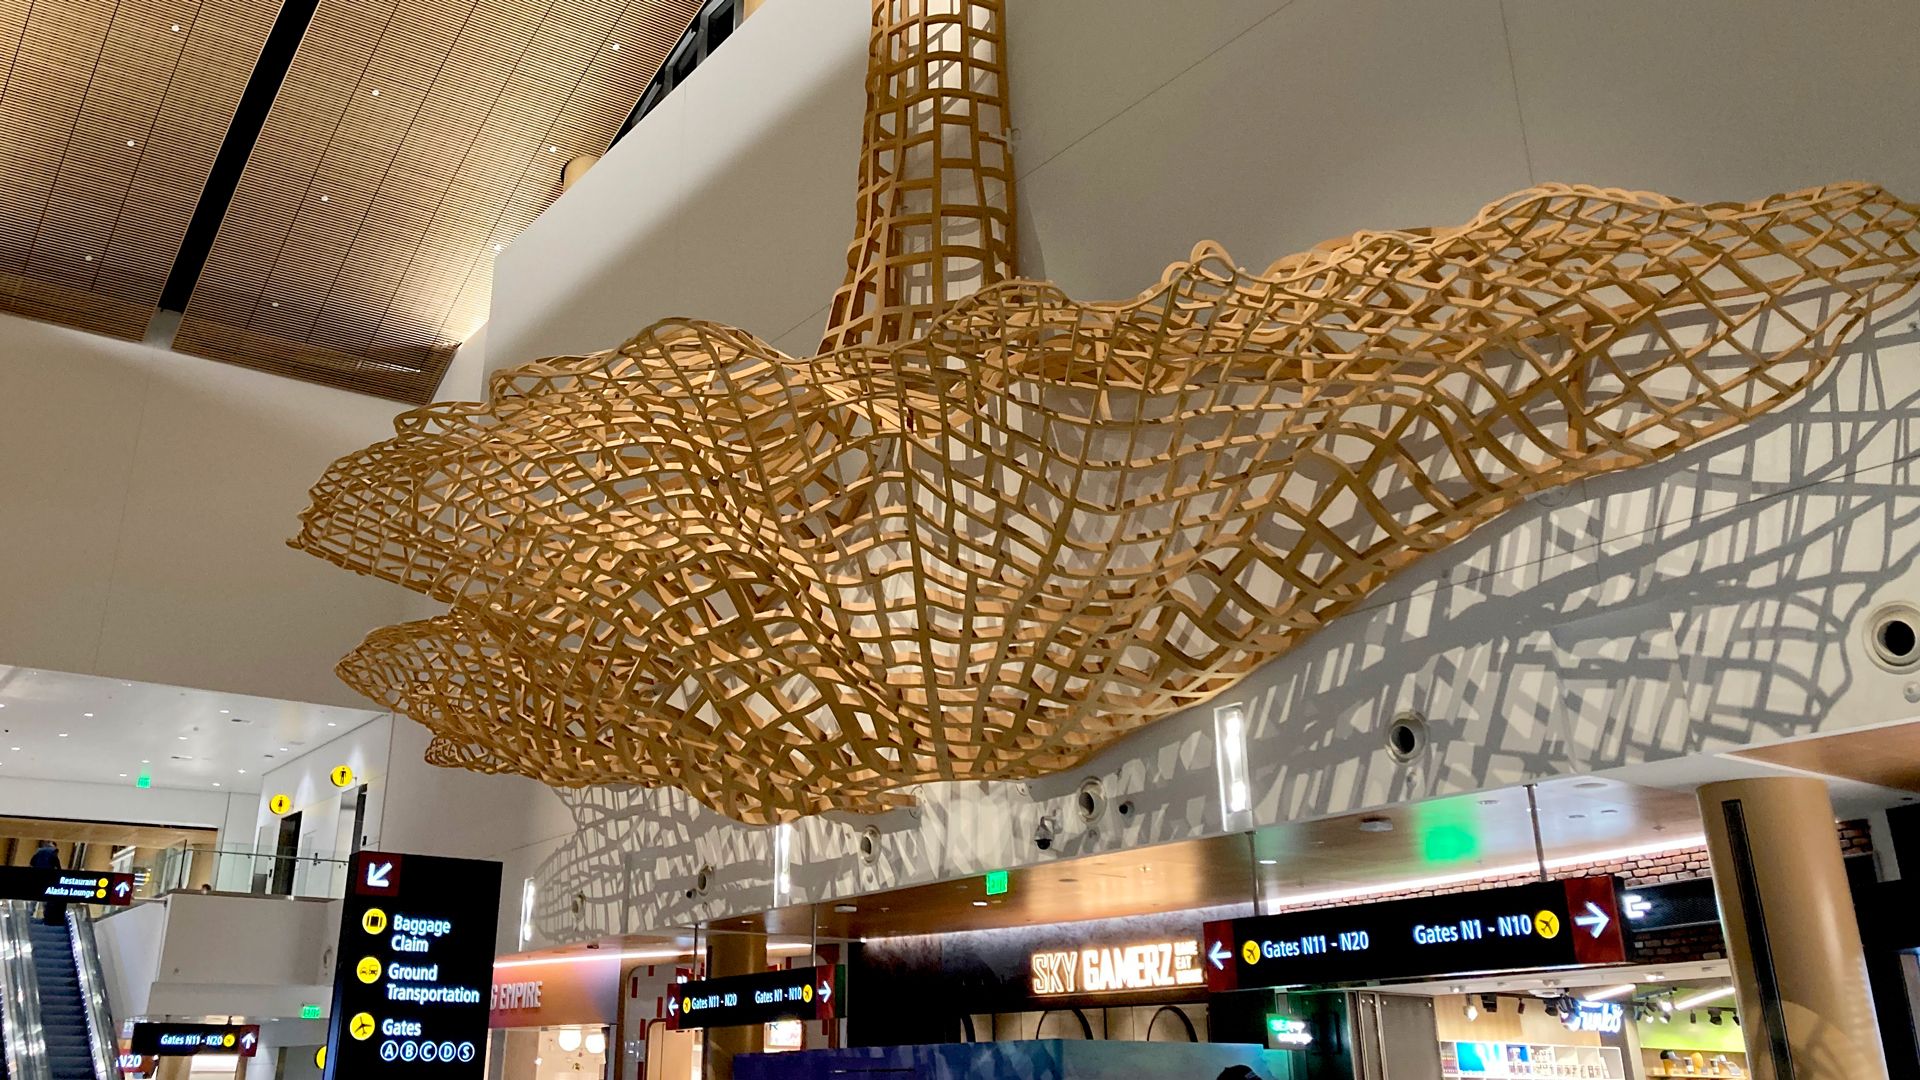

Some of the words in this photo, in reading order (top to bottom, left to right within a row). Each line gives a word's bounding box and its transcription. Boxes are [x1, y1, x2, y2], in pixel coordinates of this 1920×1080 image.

[59, 876, 97, 886] Restaurant
[45, 886, 69, 895] Alaska
[69, 888, 95, 898] Lounge
[393, 914, 451, 937] Baggage
[1413, 924, 1459, 945] Gates
[1460, 919, 1482, 940] N1
[1497, 914, 1532, 937] N10
[391, 934, 429, 952] Claim
[1262, 940, 1300, 959] Gates
[1301, 935, 1327, 955] N11
[1339, 930, 1369, 952] N20
[1031, 951, 1078, 994] SKY
[1081, 943, 1175, 991] GAMERZ
[1175, 956, 1192, 969] EAT
[388, 963, 438, 981] Ground
[386, 983, 480, 1005] Transportation
[499, 981, 543, 1009] EMPIRE
[691, 997, 708, 1010] Gates
[708, 995, 719, 1008] N11
[724, 993, 738, 1007] N20
[754, 990, 773, 1004] Gates
[773, 988, 783, 1002] N1
[788, 986, 802, 1000] N10
[382, 1018, 421, 1036] Gates
[160, 1034, 184, 1045] Gates
[185, 1034, 200, 1045] N11
[206, 1034, 223, 1046] N20
